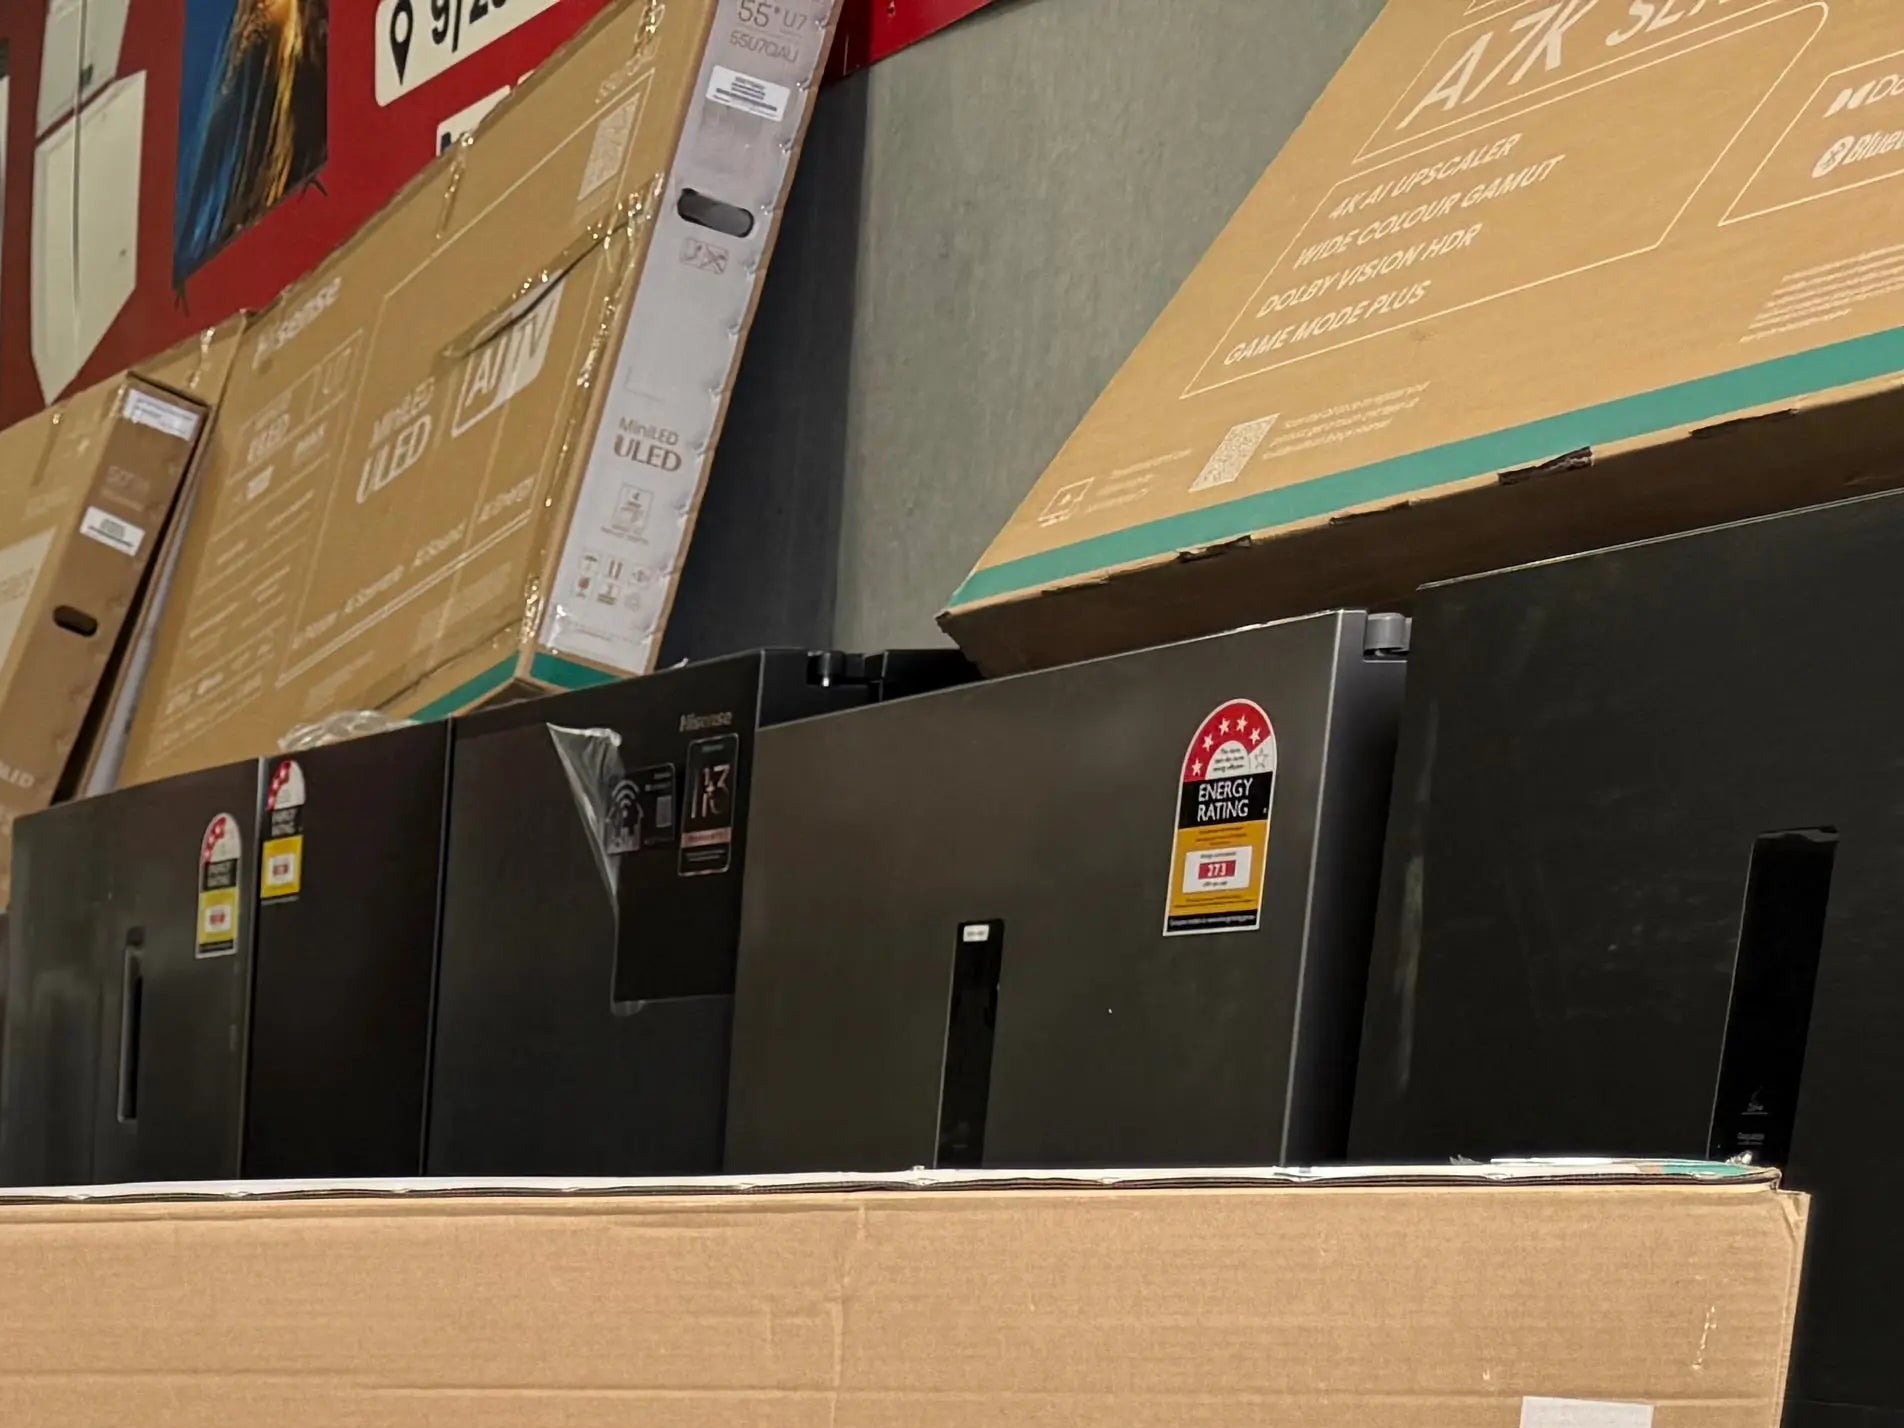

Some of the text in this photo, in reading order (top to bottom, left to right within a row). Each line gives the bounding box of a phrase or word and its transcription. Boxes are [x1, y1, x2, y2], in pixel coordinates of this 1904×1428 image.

[1328, 132, 1523, 220] 4K AI UPSCALER
[1292, 154, 1567, 270] WIDE COLOUR GAMUT
[1256, 223, 1485, 319] DOLBY VISION HDR
[1223, 279, 1432, 365] GAME MODE PLUS
[612, 434, 683, 473] ULED
[618, 416, 680, 447] MiniLED
[1197, 800, 1249, 822] RATING
[1198, 778, 1253, 802] ENERGY
